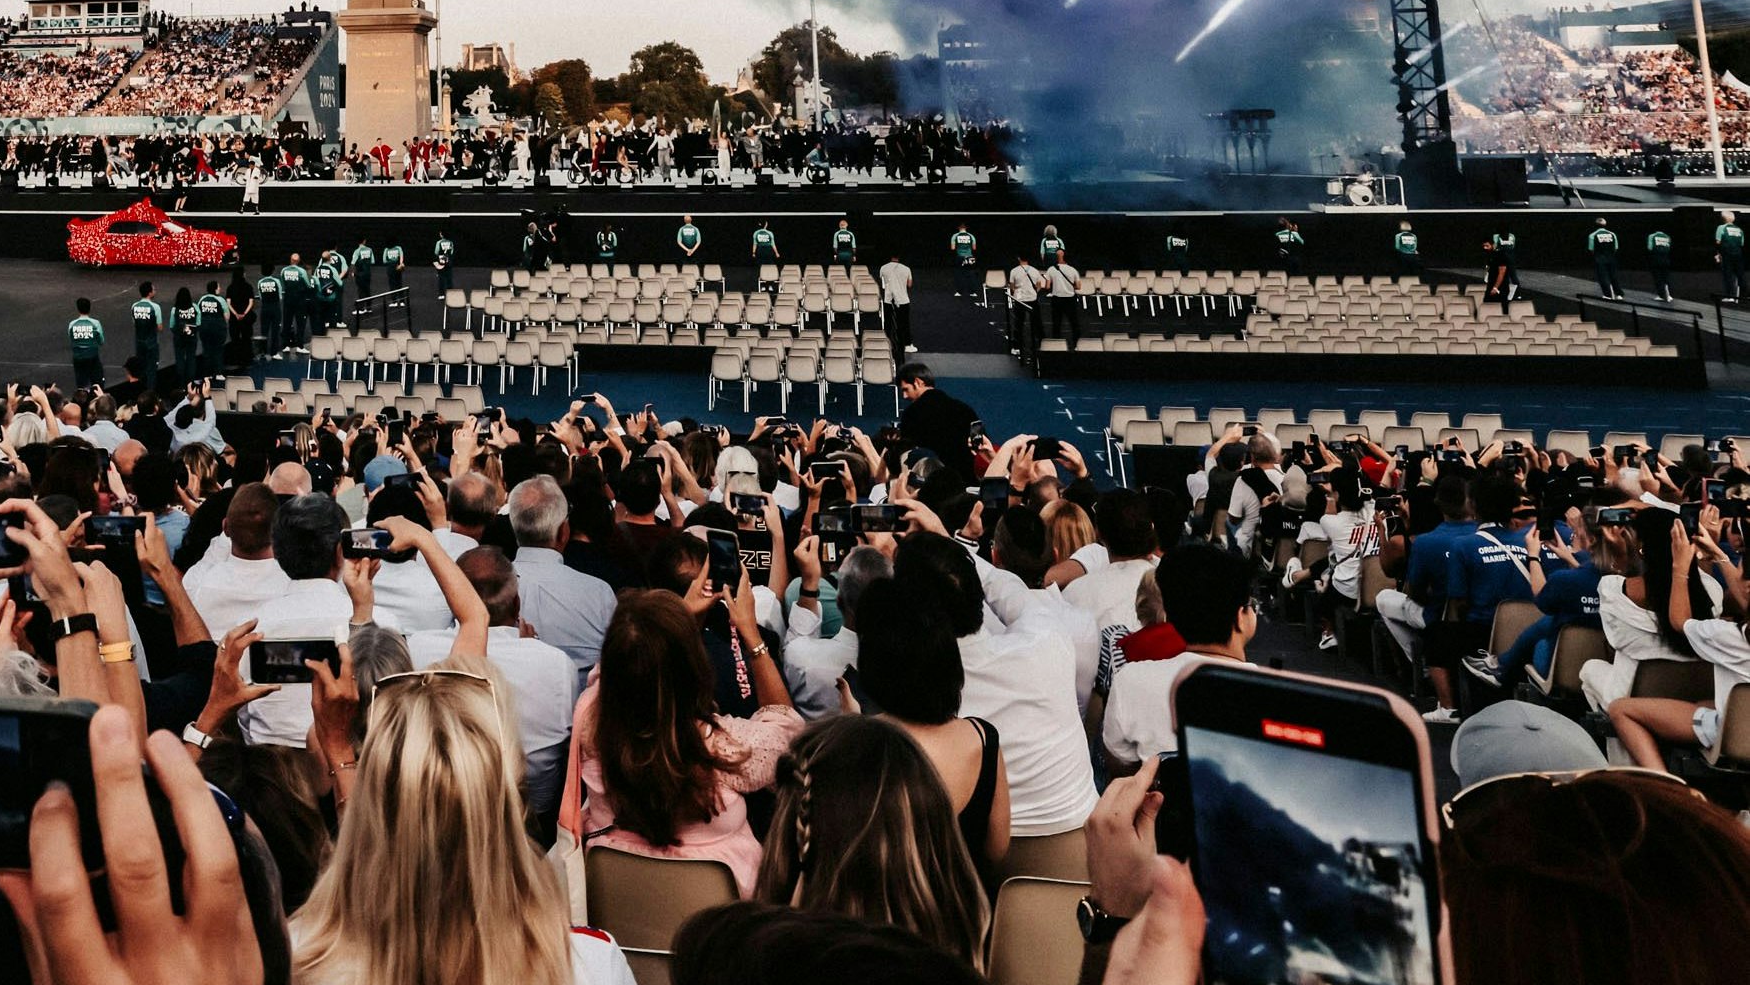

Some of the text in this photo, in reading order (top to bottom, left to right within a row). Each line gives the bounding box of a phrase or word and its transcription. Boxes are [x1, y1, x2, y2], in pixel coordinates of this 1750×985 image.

[319, 75, 335, 91] PARIS
[319, 93, 336, 107] 2024
[133, 306, 151, 314] PARIS
[72, 325, 93, 333] PARIS
